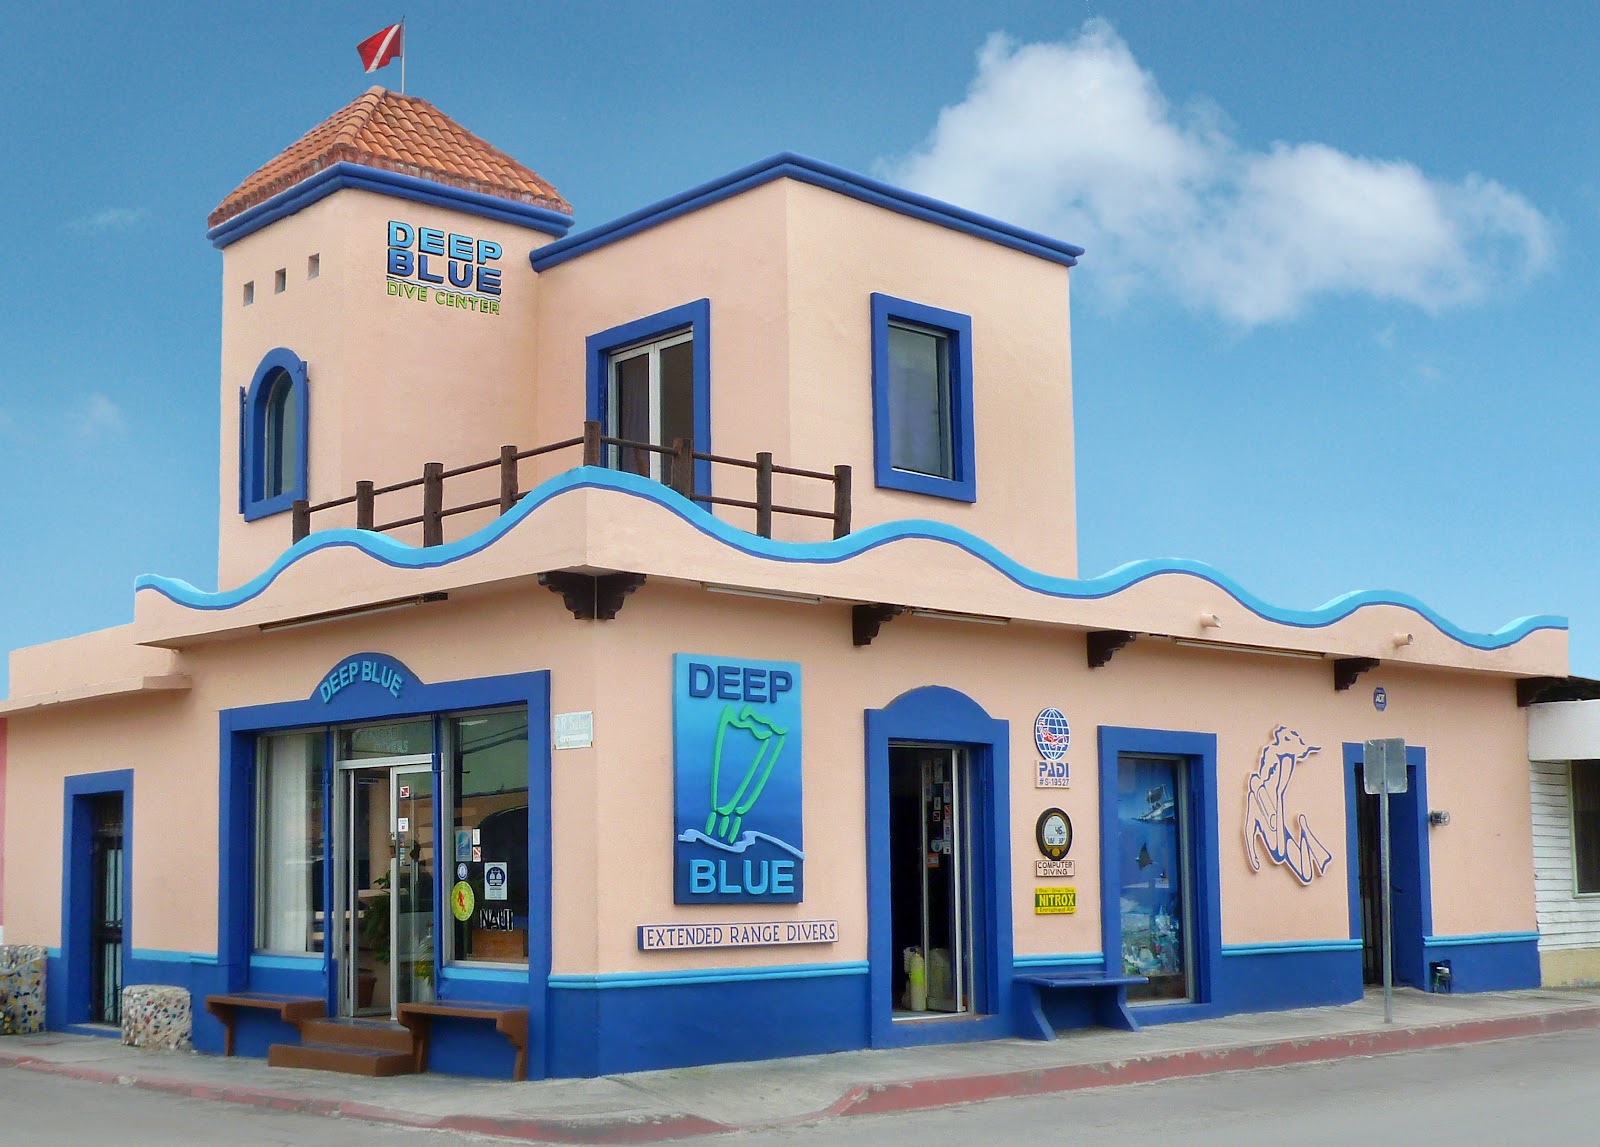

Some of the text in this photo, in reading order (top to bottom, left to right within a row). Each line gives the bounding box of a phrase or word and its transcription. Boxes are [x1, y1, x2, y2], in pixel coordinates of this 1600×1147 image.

[388, 220, 503, 265] DEEP
[387, 247, 502, 296] BLUE
[387, 281, 500, 315] DIVE CENTER
[320, 661, 404, 704] DEEP BLUE
[688, 662, 793, 703] DEEP
[1038, 761, 1070, 778] PADI
[689, 859, 795, 895] BLUE
[1037, 861, 1073, 869] COMPUTER
[1043, 868, 1068, 876] DIVING
[1039, 893, 1075, 907] NITROX
[647, 923, 836, 947] EXTENDED RANGE DIVERS
